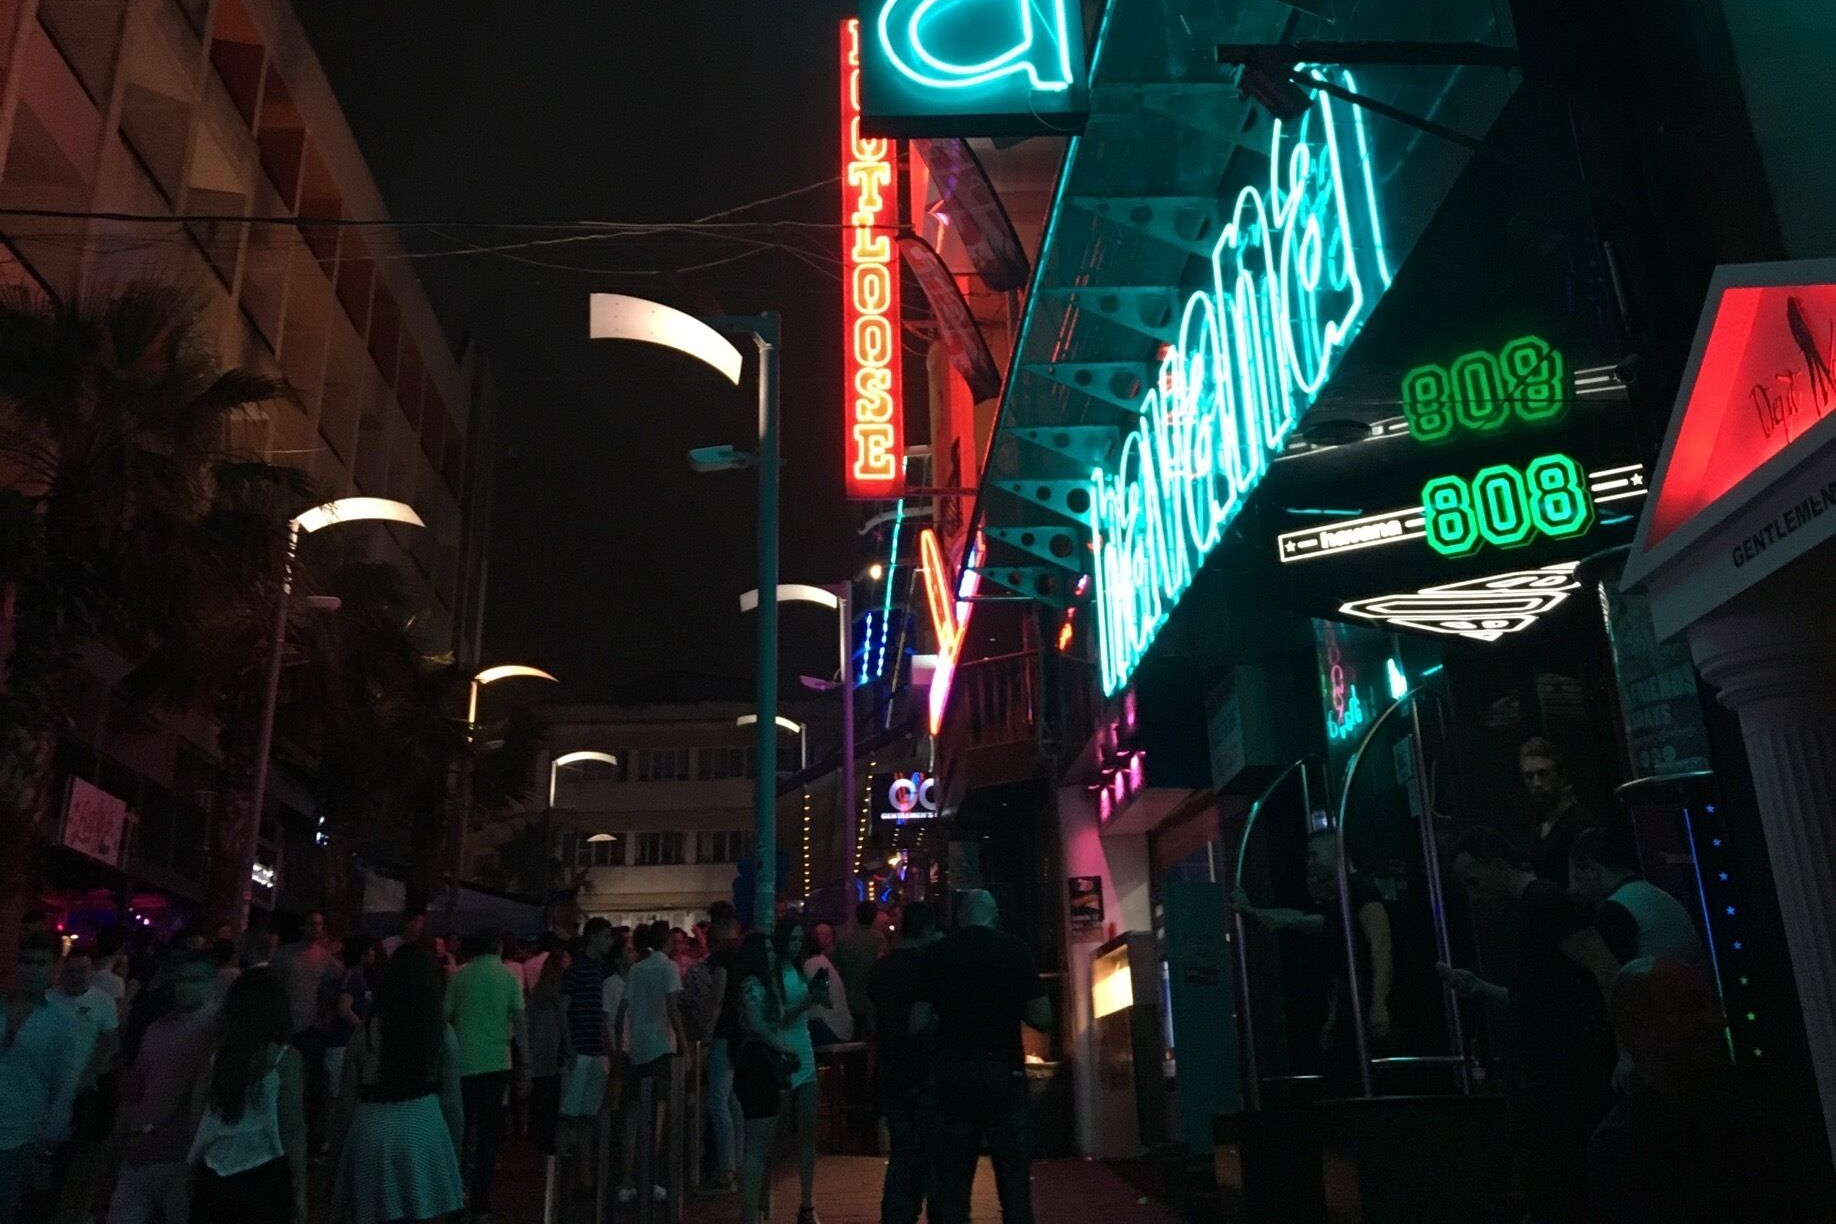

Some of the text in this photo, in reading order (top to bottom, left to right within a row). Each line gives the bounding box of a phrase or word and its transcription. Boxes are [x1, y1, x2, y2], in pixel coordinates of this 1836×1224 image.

[849, 19, 896, 481] OTLOOSE
[1090, 62, 1391, 697] havana
[1320, 520, 1403, 549] havana
[1421, 452, 1594, 556] 808
